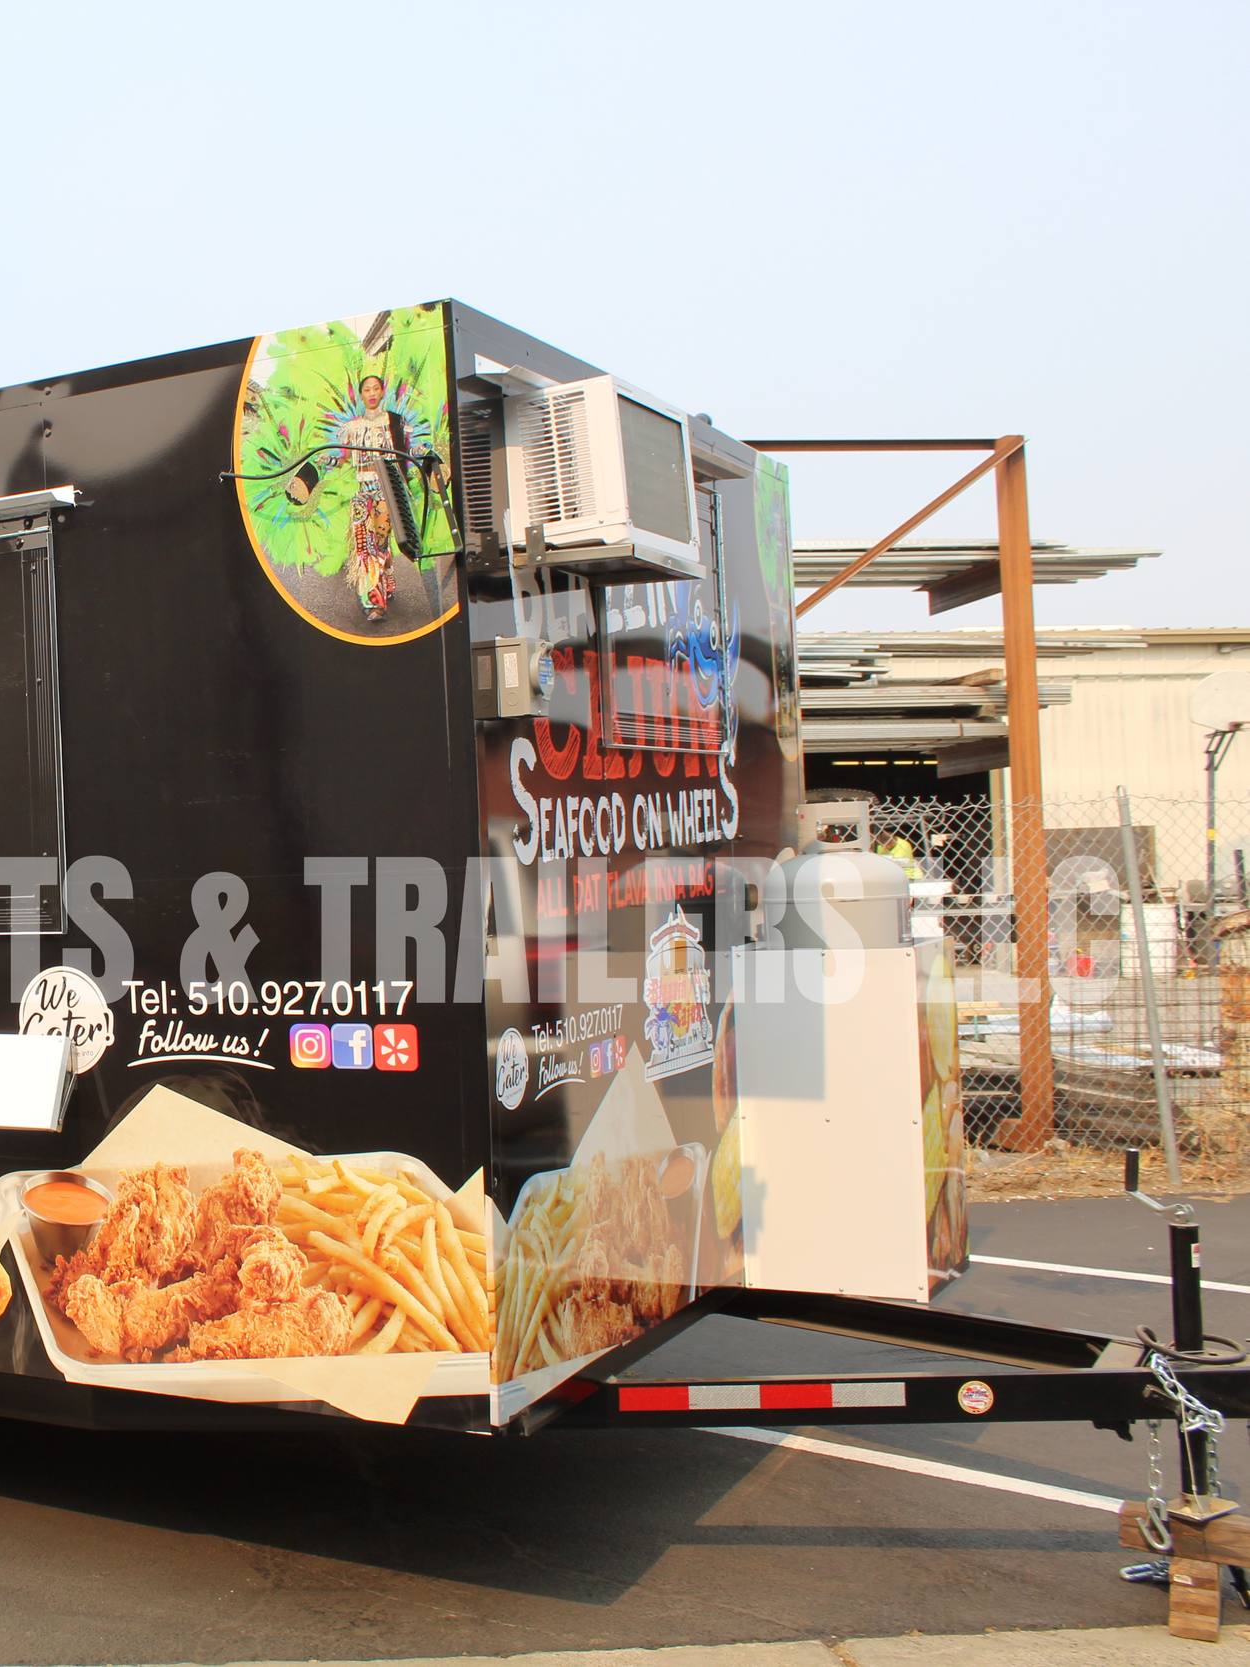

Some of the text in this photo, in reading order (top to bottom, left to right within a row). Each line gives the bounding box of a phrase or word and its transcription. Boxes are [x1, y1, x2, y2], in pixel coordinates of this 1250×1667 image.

[510, 737, 740, 866] SEAFOOD ON WHEELS
[536, 876, 569, 920] ALL
[573, 873, 601, 916] DAT
[607, 869, 651, 911] FLAVA
[654, 865, 687, 902] INNA
[688, 862, 715, 898] BAG
[35, 976, 81, 1011] We
[121, 980, 414, 1017] Tel: 510.927.0117
[531, 1003, 623, 1054] Tel: 510.927.0117
[501, 1034, 517, 1063] We
[498, 1059, 528, 1098] Cater!
